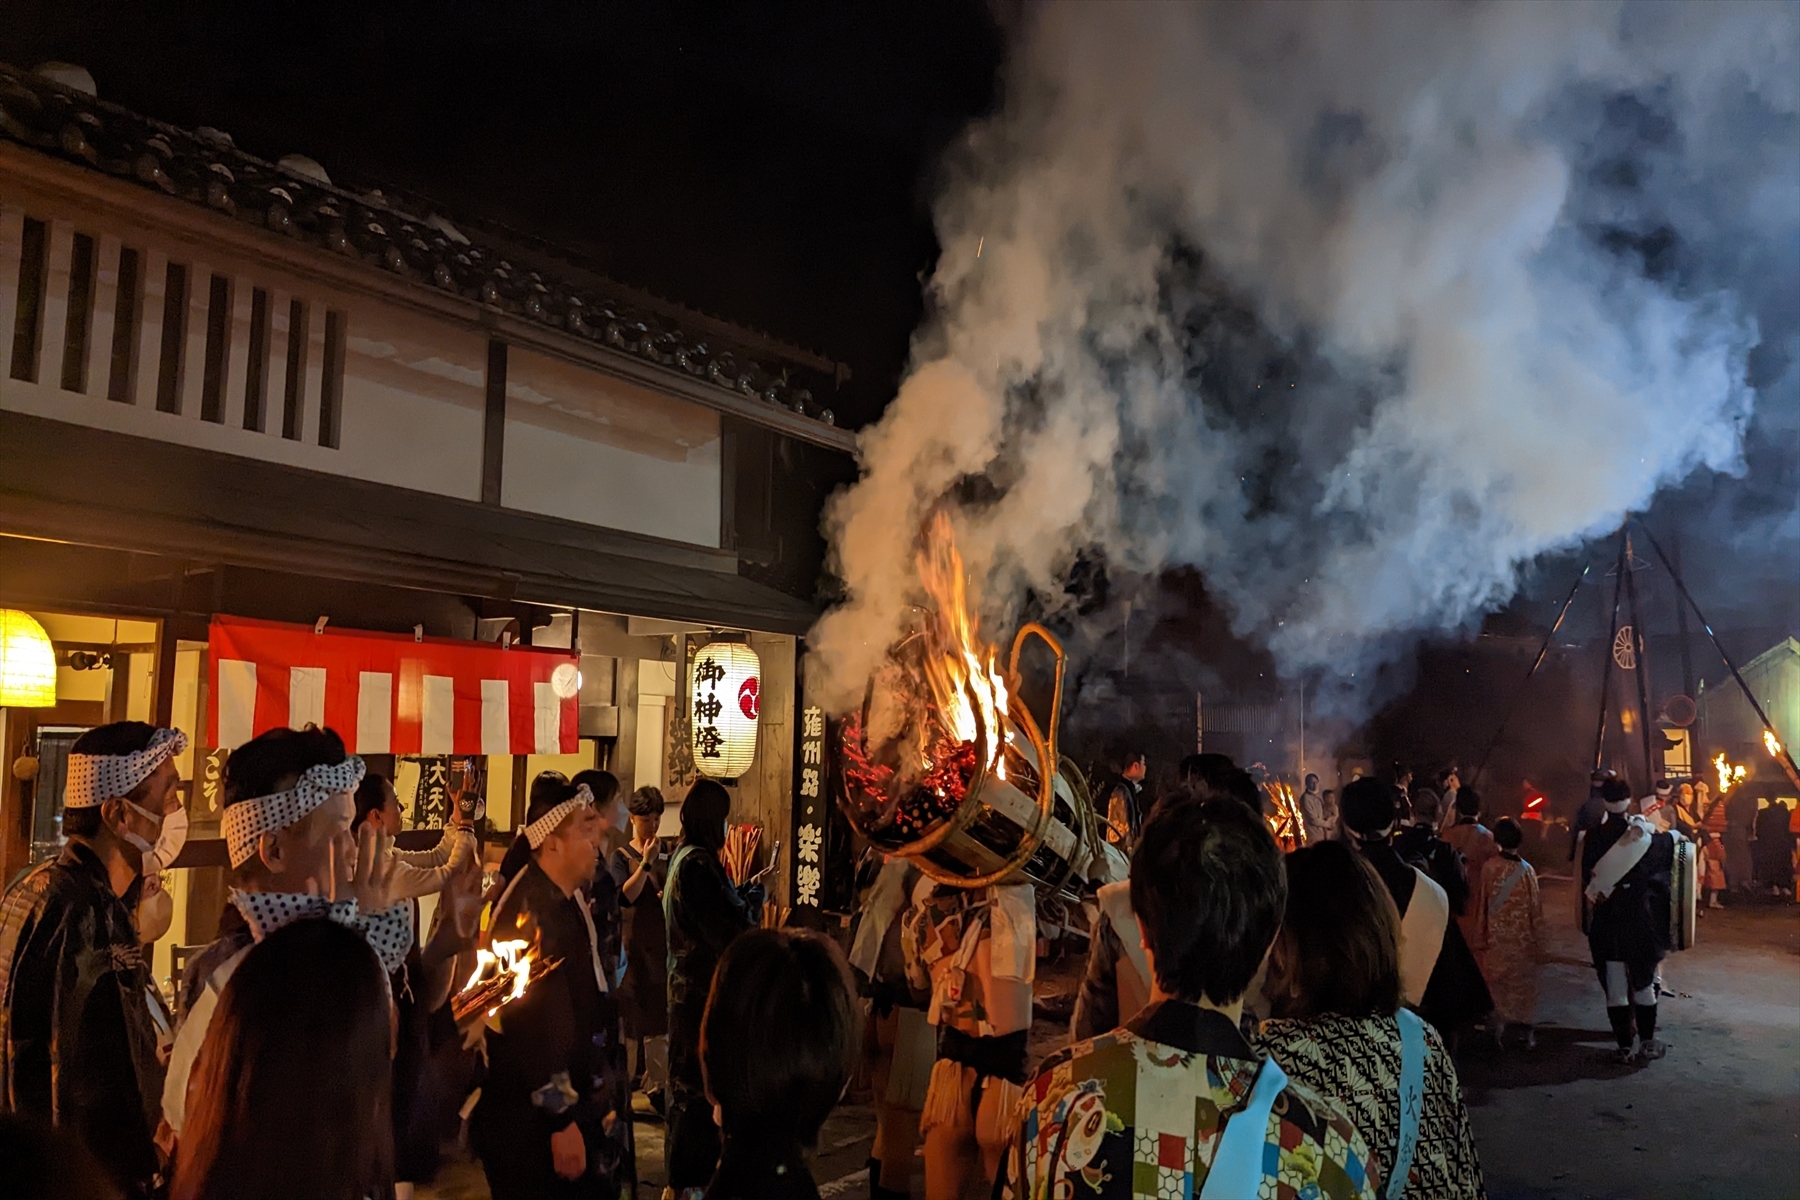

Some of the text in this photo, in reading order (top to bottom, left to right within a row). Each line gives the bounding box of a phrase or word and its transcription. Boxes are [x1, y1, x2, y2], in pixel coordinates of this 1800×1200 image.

[695, 656, 726, 759] 御神燈
[426, 760, 447, 830] 大天狗
